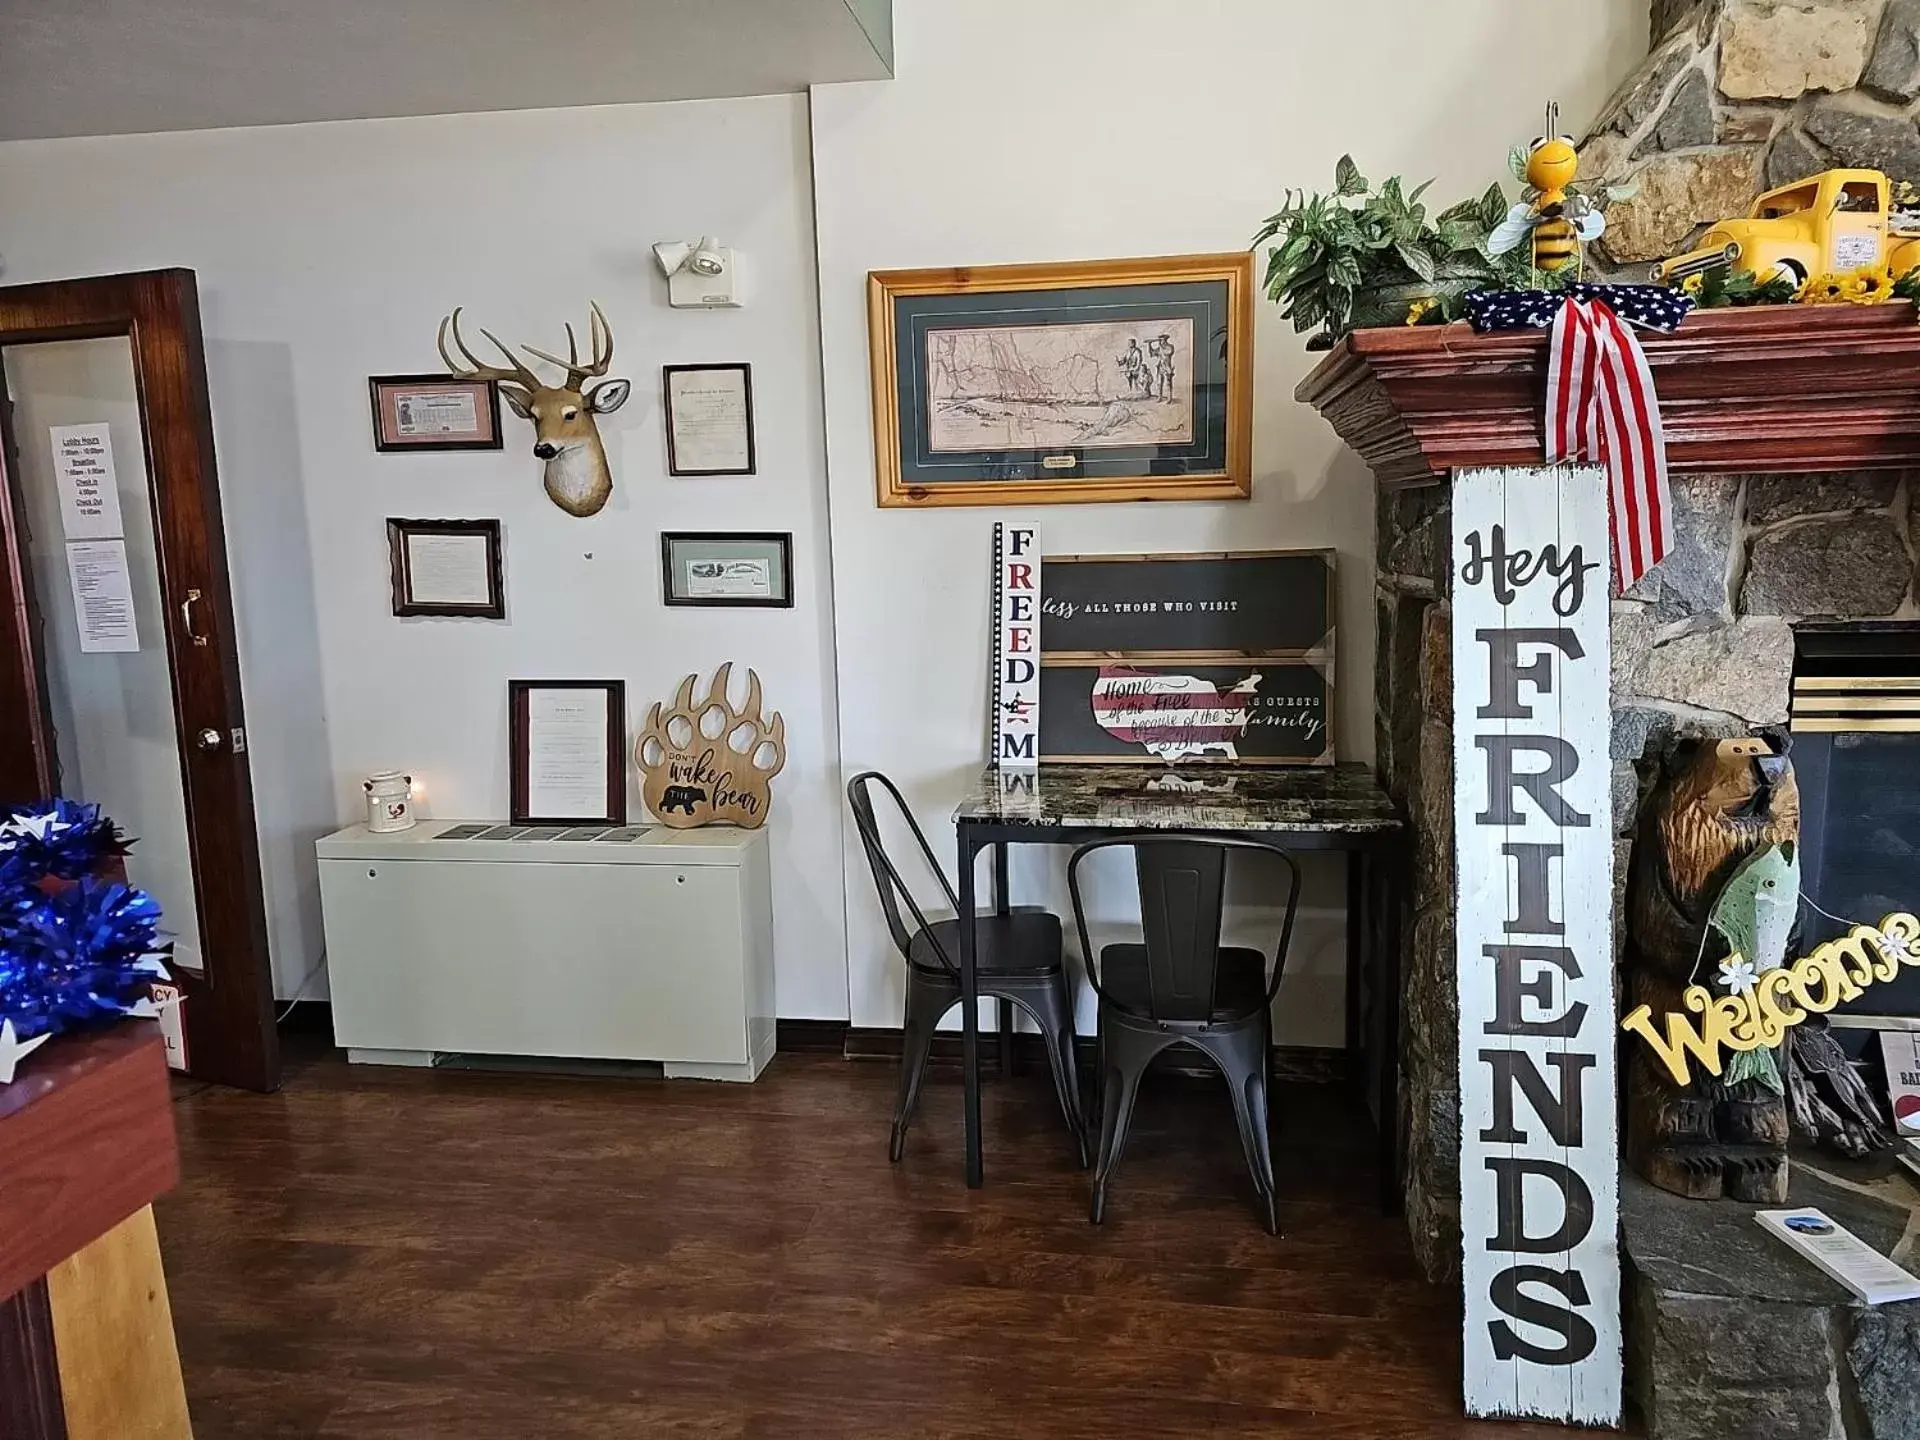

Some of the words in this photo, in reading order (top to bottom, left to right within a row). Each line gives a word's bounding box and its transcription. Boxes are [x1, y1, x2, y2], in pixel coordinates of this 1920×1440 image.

[1461, 523, 1600, 617] Hey
[1041, 597, 1080, 619] less
[1084, 602, 1109, 613] ALL
[1114, 601, 1157, 613] THOSE
[1163, 601, 1194, 612] WHO
[1199, 601, 1239, 612] VISIT
[1101, 678, 1168, 701] Home
[1247, 696, 1260, 707] S
[1126, 702, 1145, 716] the
[1151, 692, 1192, 713] Free
[1131, 713, 1178, 731] because
[1183, 708, 1199, 726] of
[1200, 709, 1221, 725] the
[1240, 710, 1326, 741] family
[668, 752, 697, 763] DON'T
[669, 748, 720, 785] wake
[711, 771, 763, 816] bear
[1475, 627, 1597, 1366] FRIENDS
[1619, 912, 1920, 1087] Welcome
